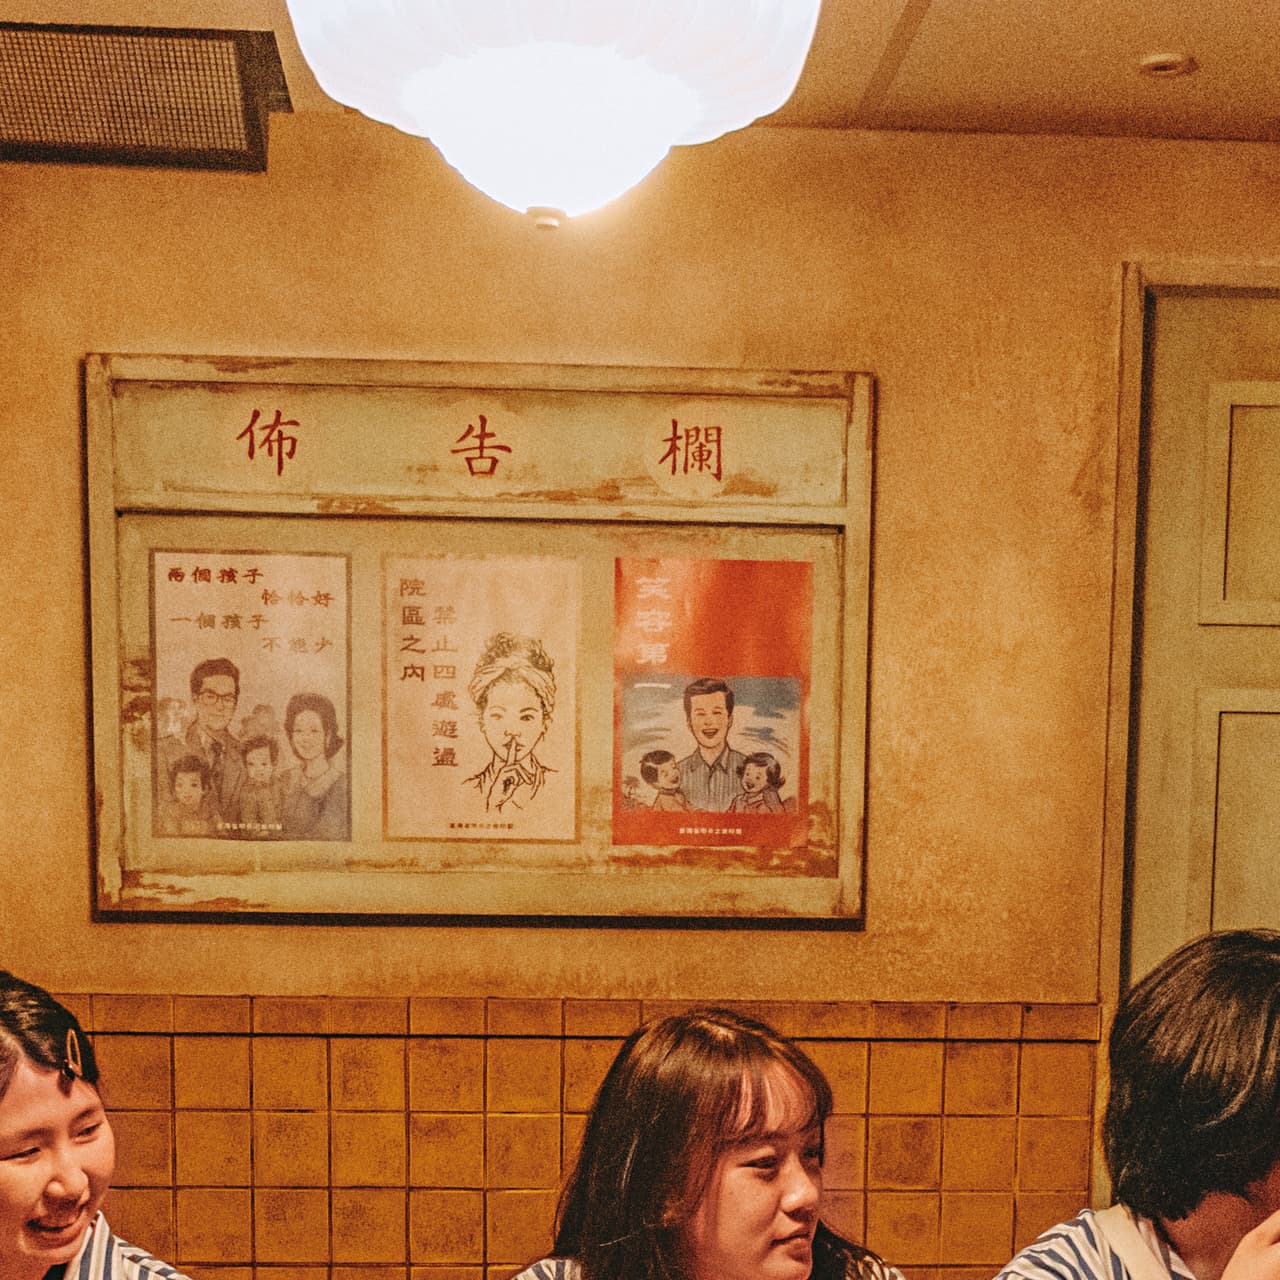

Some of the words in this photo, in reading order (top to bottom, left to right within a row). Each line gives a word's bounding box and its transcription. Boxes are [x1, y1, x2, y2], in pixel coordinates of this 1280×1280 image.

[236, 408, 722, 480] 佈告欄
[167, 566, 264, 585] 兩個孩子
[261, 588, 335, 608] 恰恰好
[170, 612, 269, 630] 一個孩子
[399, 578, 427, 682] 院區之內
